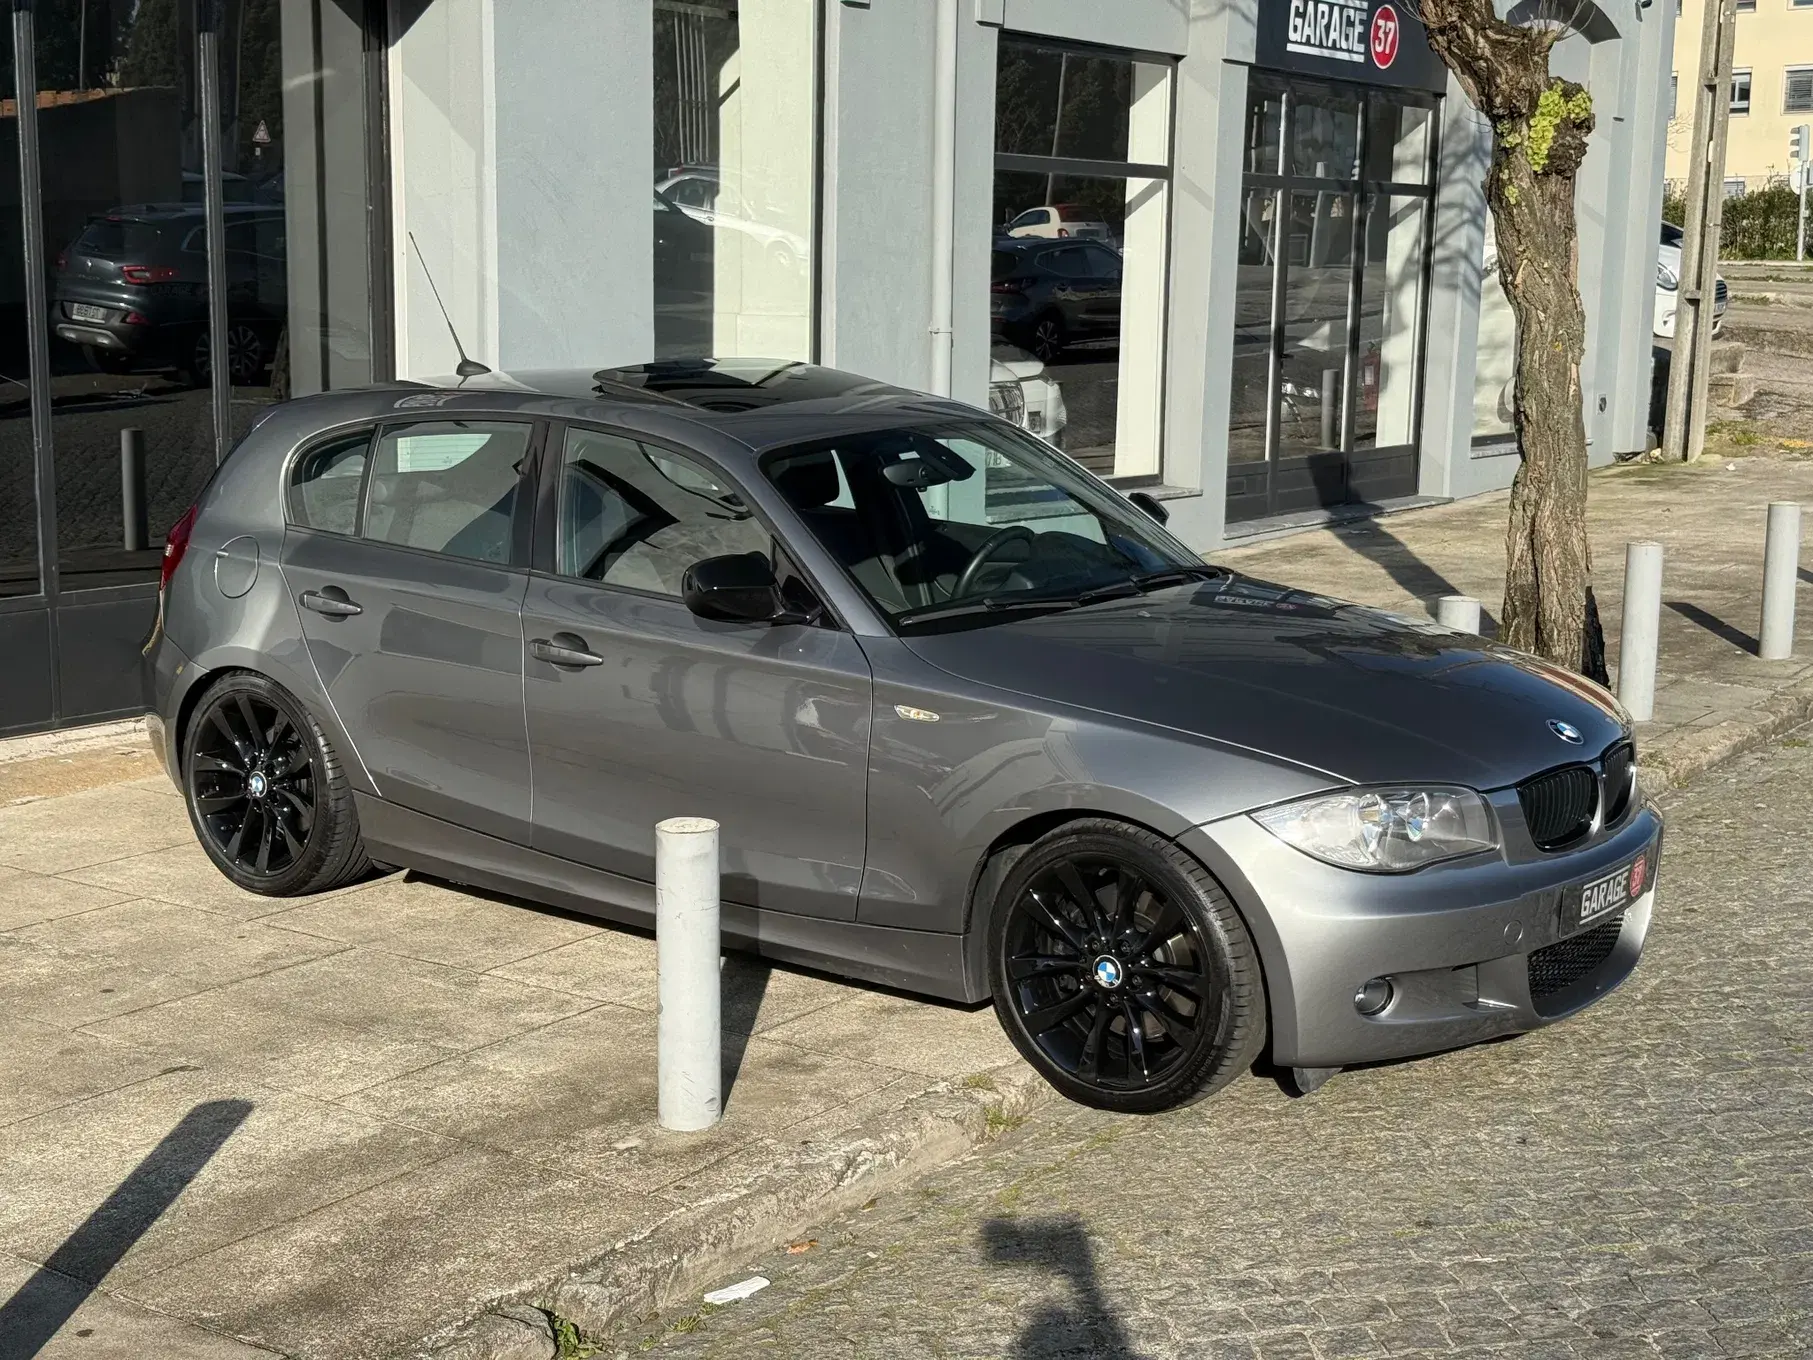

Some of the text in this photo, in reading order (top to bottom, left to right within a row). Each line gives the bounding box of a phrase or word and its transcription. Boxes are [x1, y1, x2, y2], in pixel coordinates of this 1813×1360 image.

[1288, 0, 1395, 54] GARAGE 37
[1580, 871, 1629, 917] GARAGE
